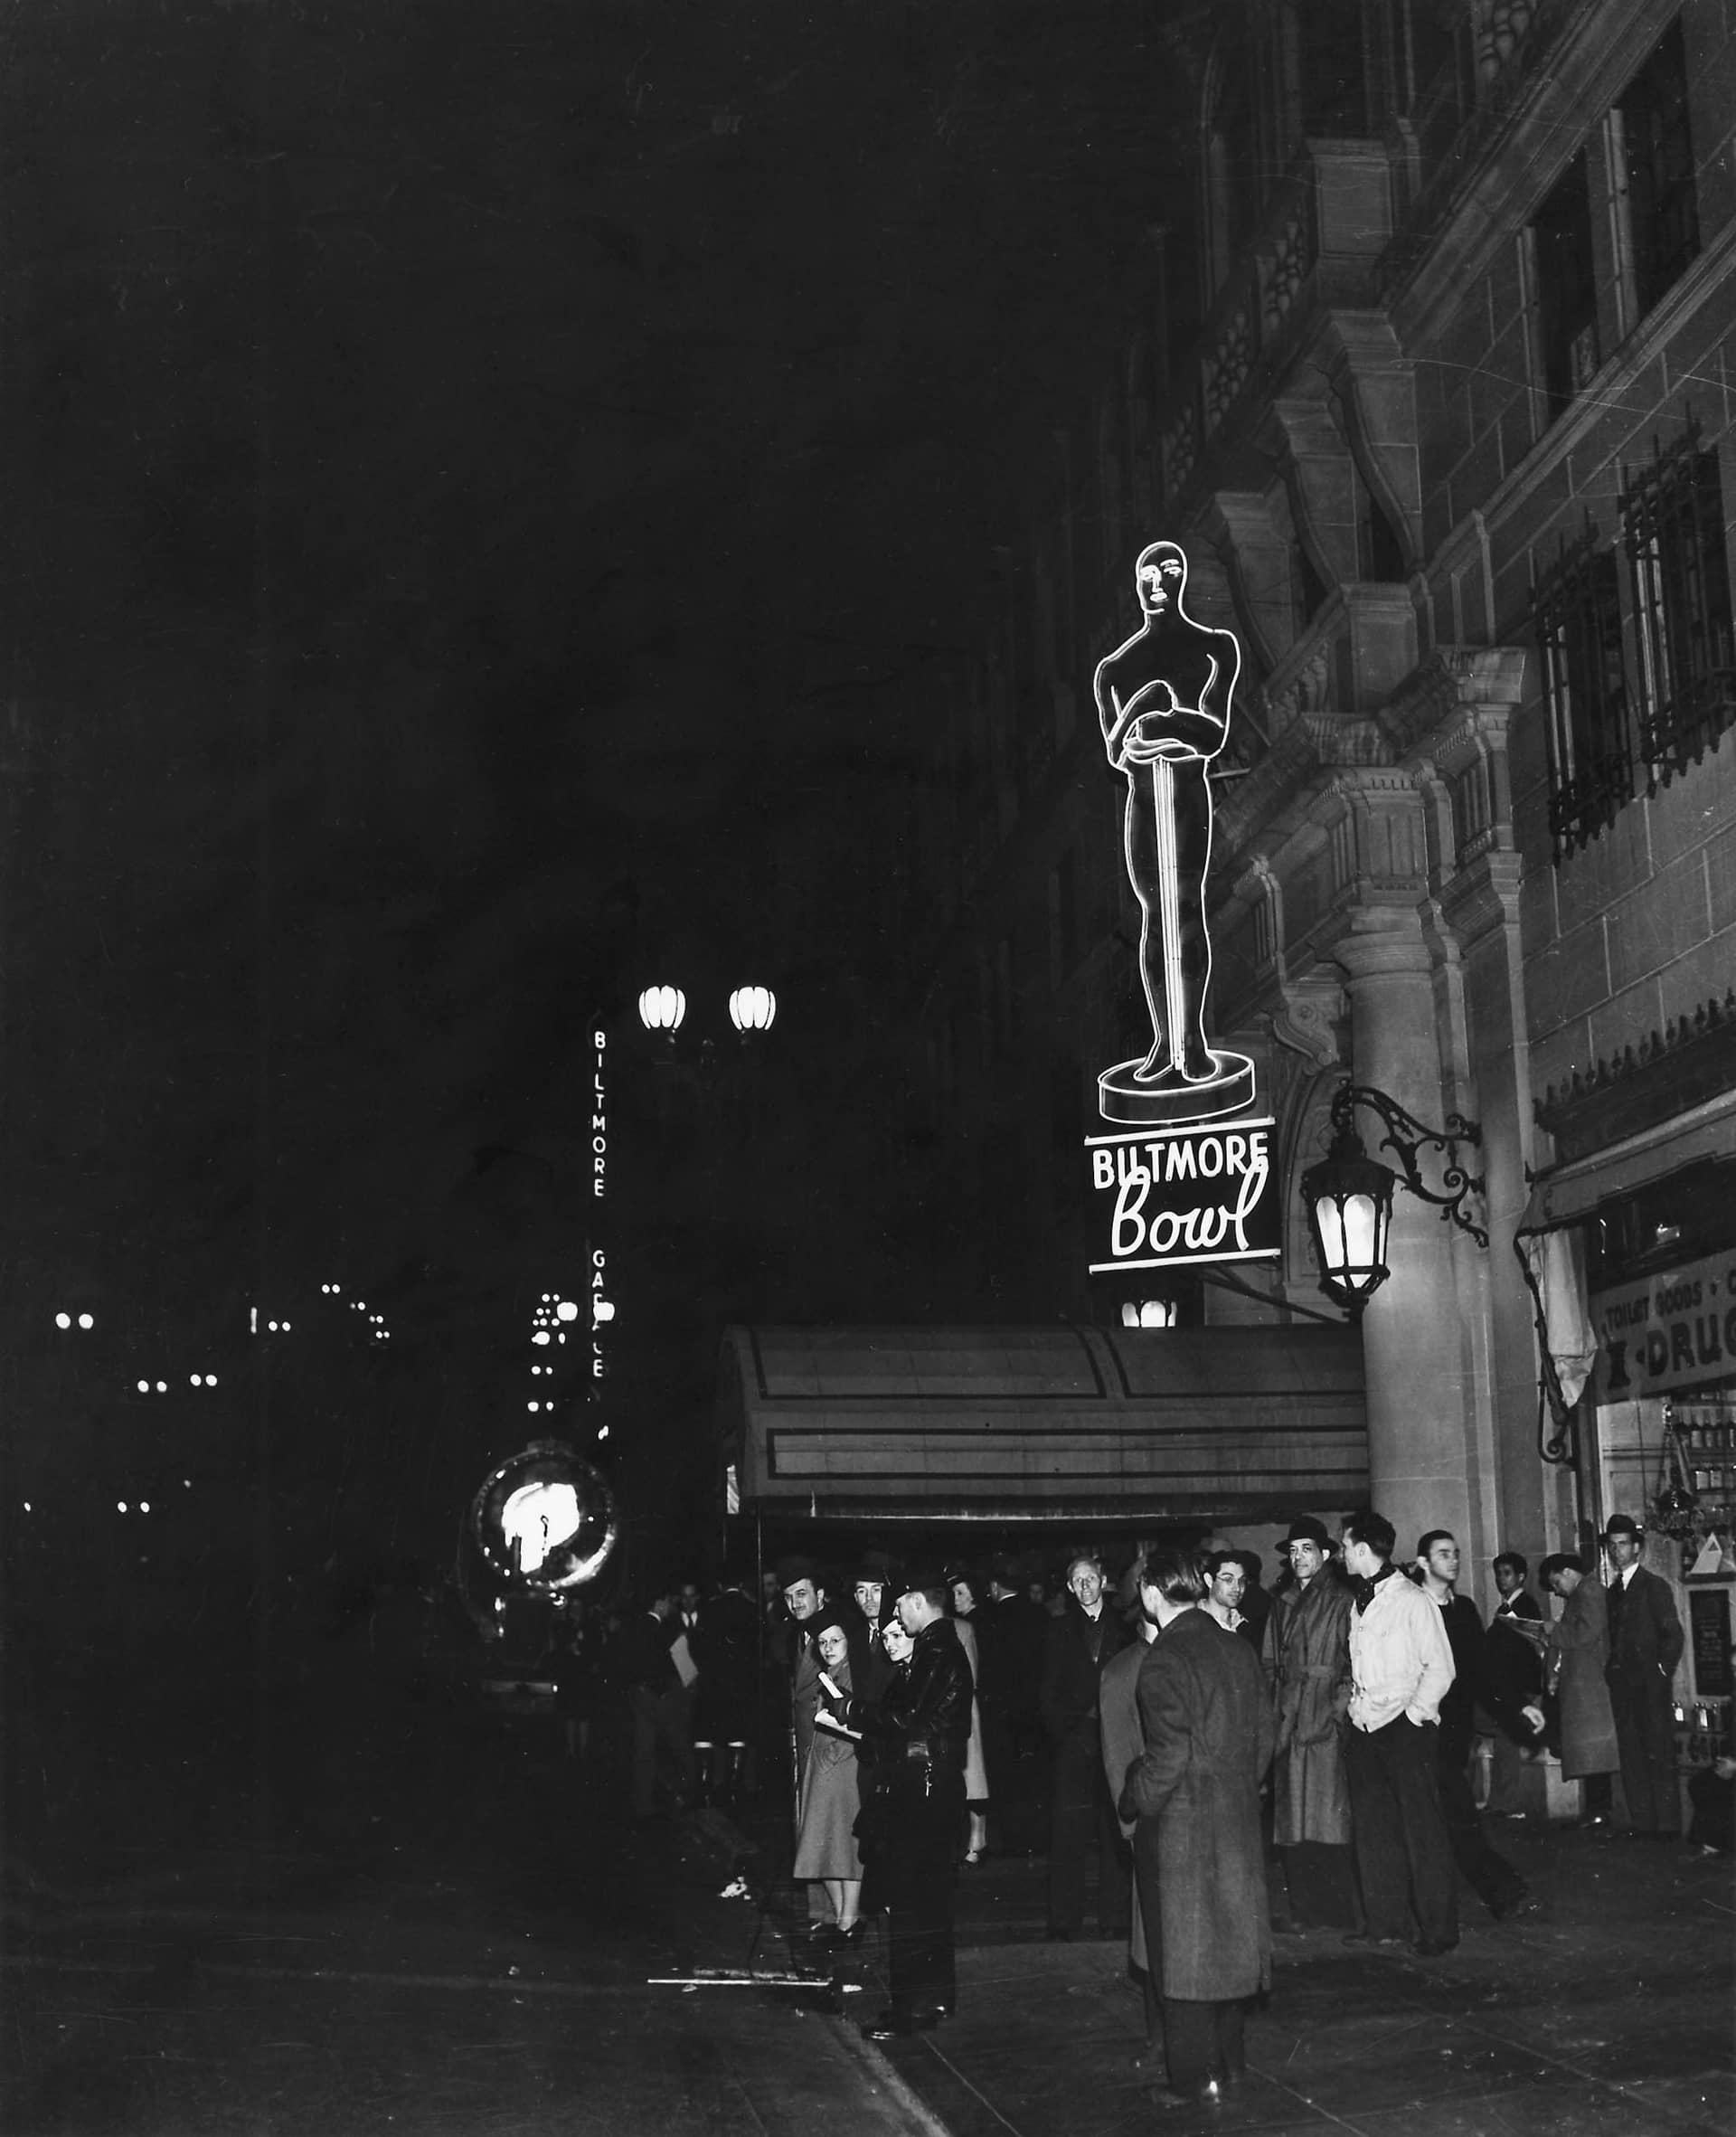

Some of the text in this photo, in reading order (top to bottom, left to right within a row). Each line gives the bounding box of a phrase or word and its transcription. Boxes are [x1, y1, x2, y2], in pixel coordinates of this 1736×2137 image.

[592, 1031, 606, 1196] BILTMORE
[1092, 1132, 1268, 1189] BILTMORE
[1112, 1154, 1269, 1256] Bowl
[1606, 1296, 1650, 1331] TOILET
[1656, 1281, 1703, 1318] GOODS
